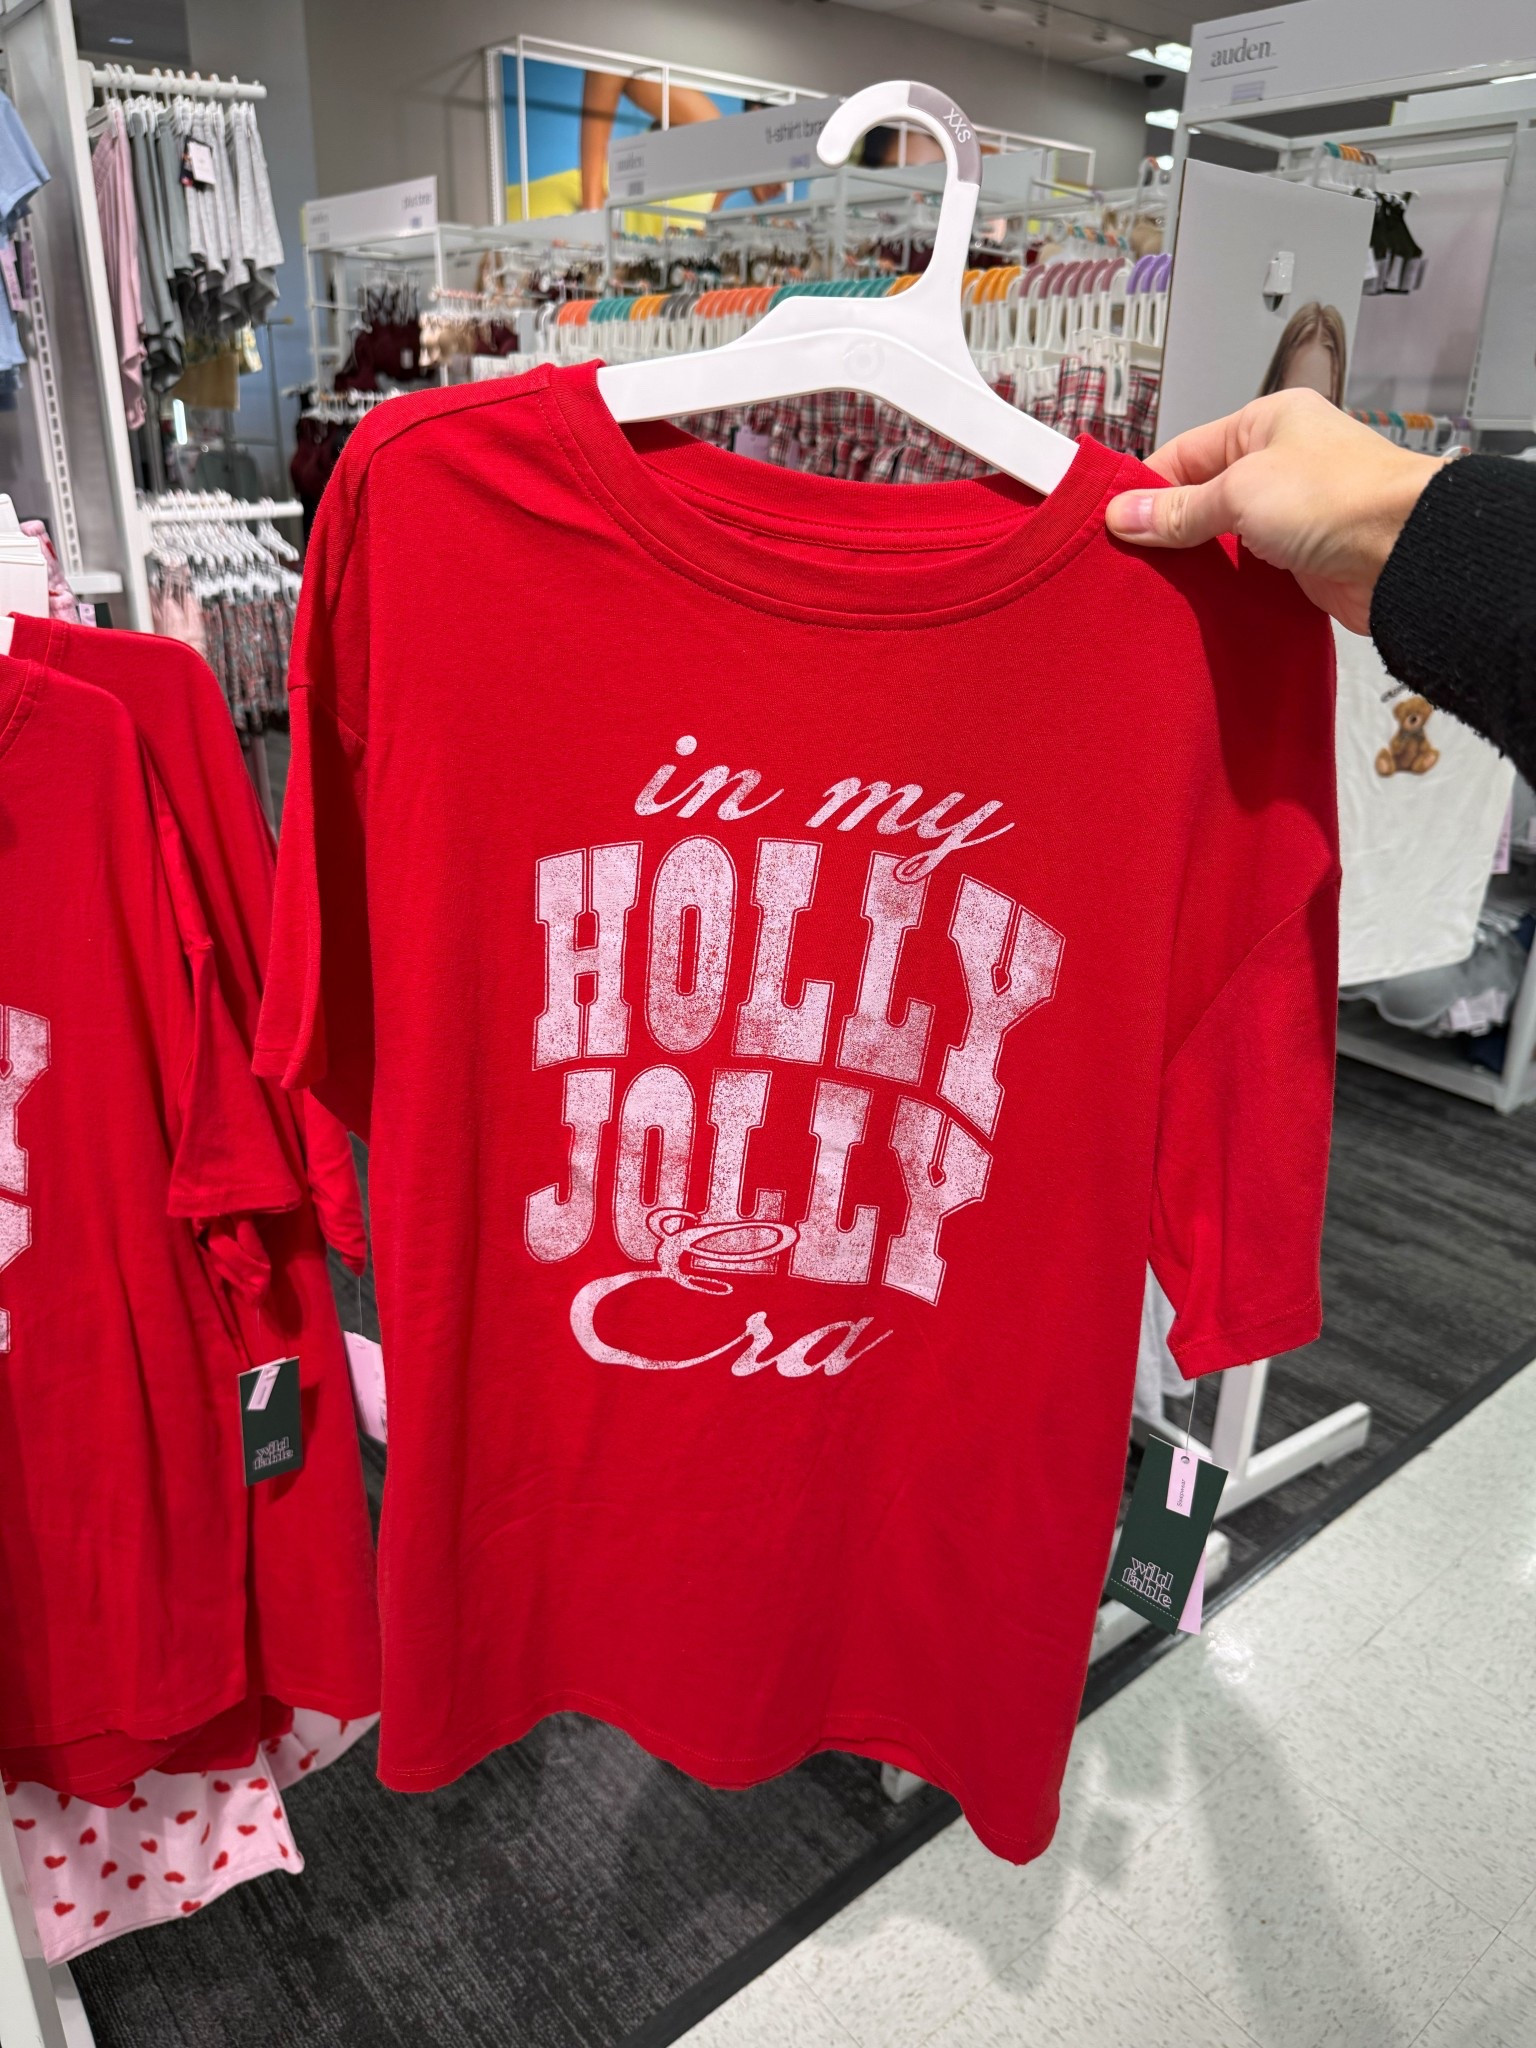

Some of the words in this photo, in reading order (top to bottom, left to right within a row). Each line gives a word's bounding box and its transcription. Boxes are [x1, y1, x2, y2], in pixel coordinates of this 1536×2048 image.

[1210, 37, 1271, 68] auden
[943, 107, 971, 143] XXS
[634, 735, 784, 821] in
[806, 776, 1015, 883] my
[533, 835, 1066, 1140] HOLLY
[524, 1063, 993, 1307] JOLLY
[569, 1208, 893, 1378] Era
[1121, 1567, 1172, 1610] fable
[1131, 1556, 1174, 1591] wild
